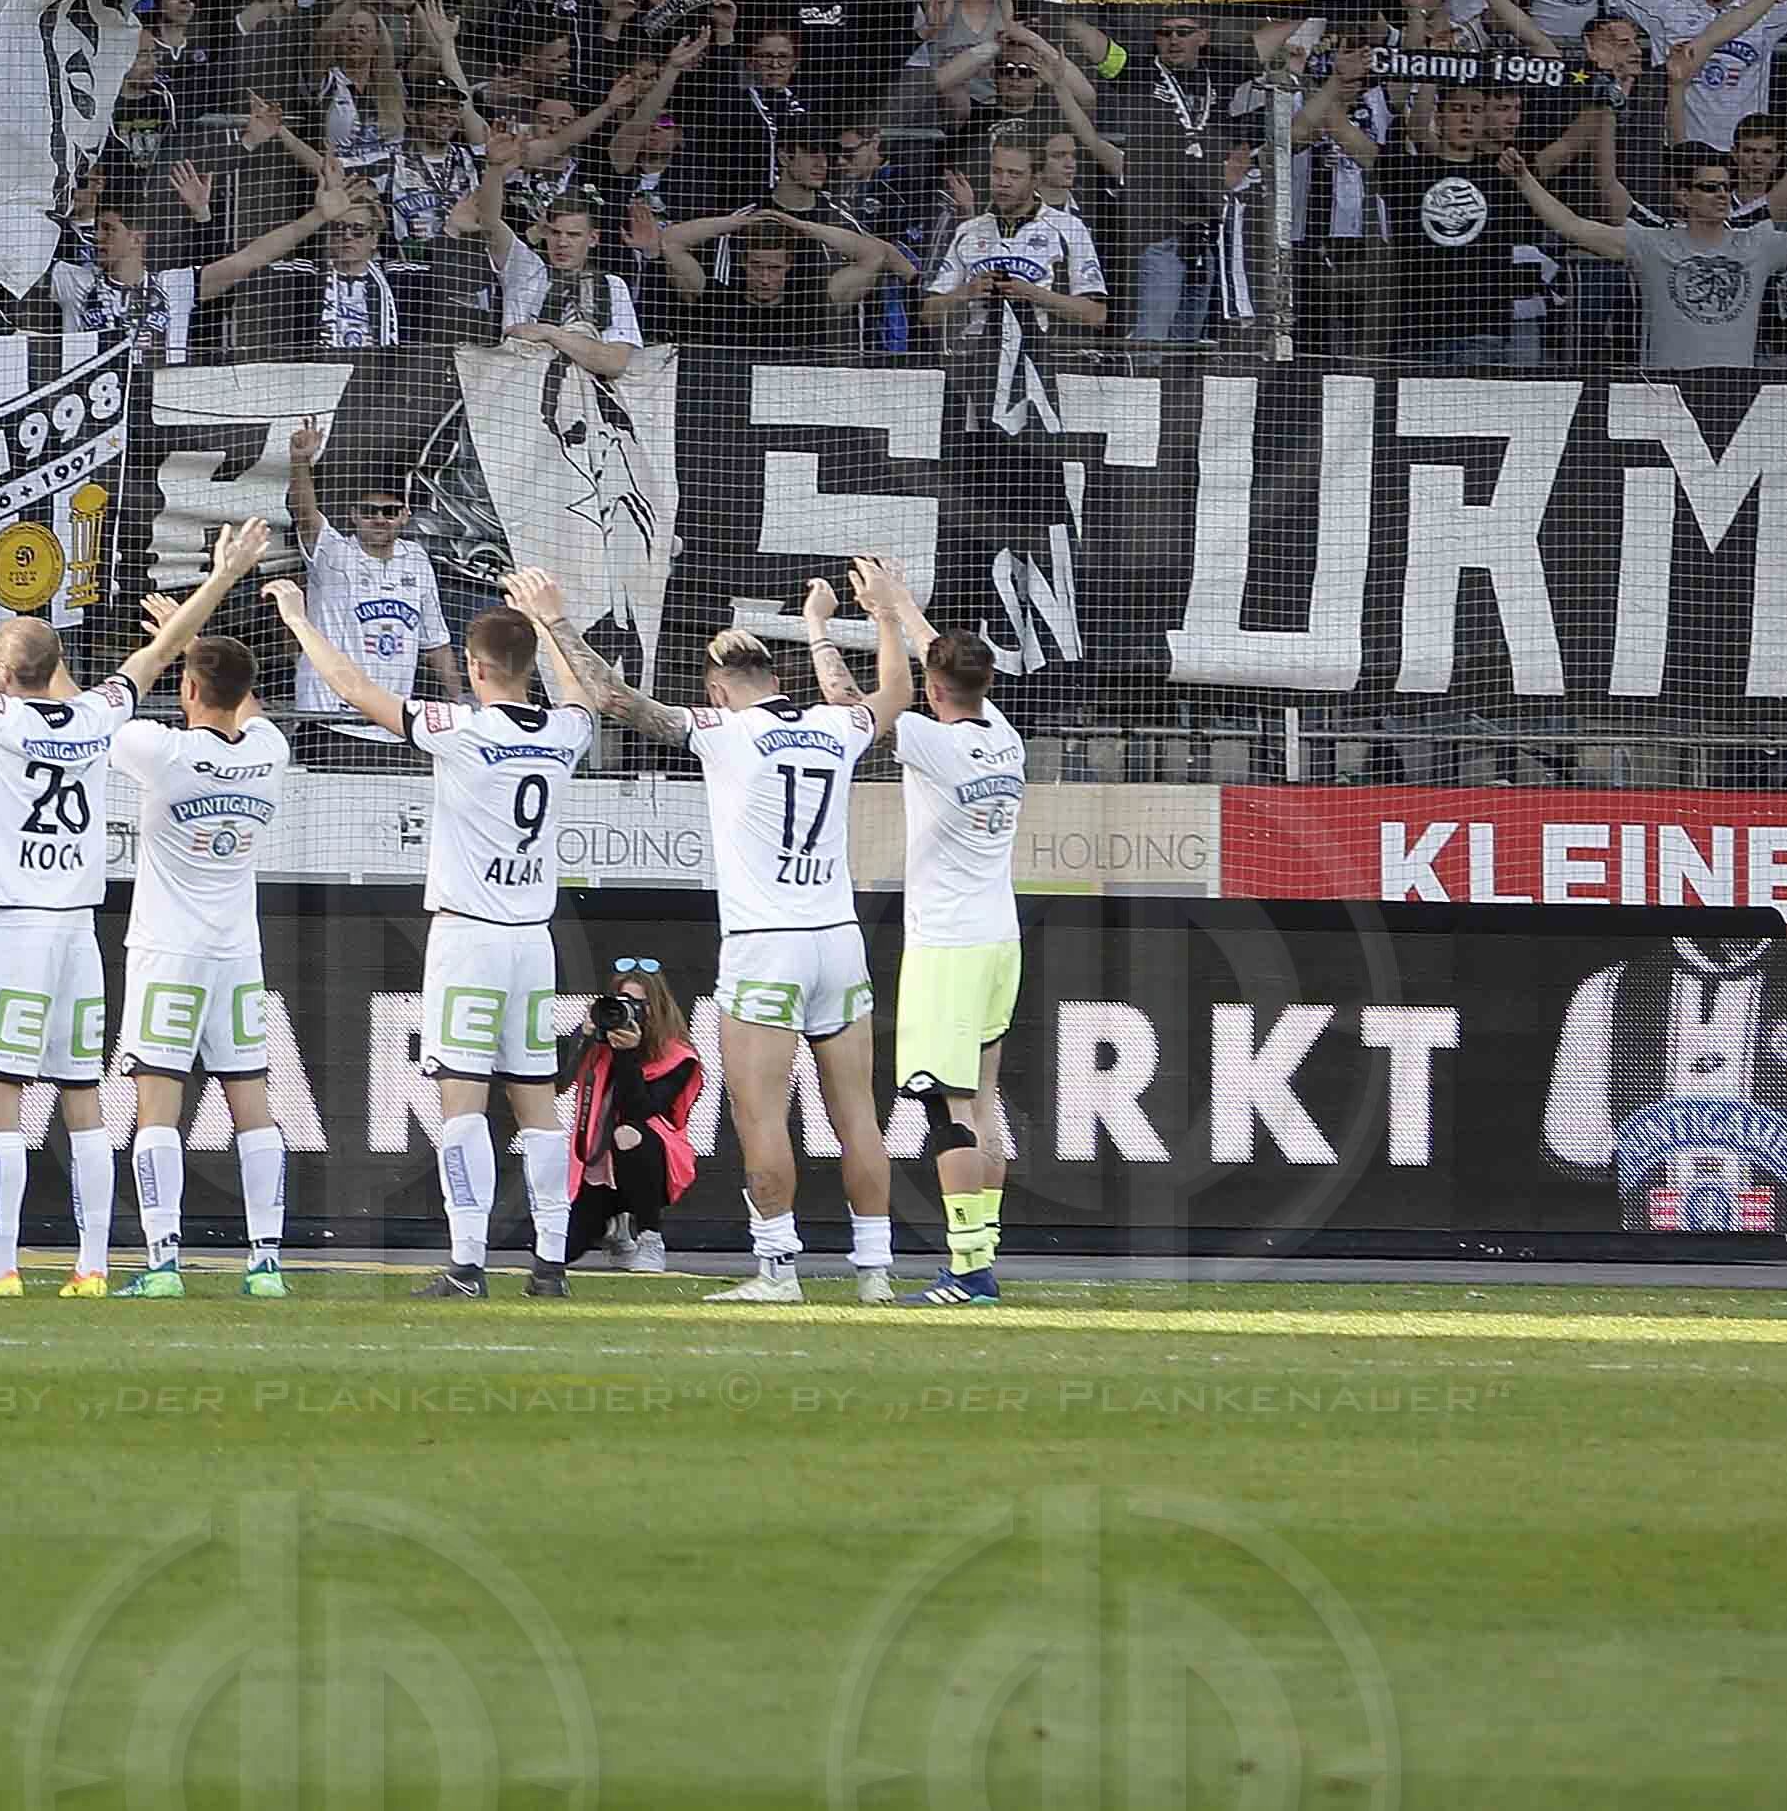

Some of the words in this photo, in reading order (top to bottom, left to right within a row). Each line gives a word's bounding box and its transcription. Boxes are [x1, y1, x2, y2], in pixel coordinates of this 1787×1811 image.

[1367, 46, 1479, 82] Champ
[1491, 53, 1566, 87] 1998
[39, 450, 98, 487] 1997
[213, 763, 273, 780] LOTTO
[513, 773, 549, 854] 9
[777, 763, 837, 855] 17
[556, 821, 706, 869] OLDING
[1030, 830, 1208, 873] HOLDING
[484, 856, 544, 887] ALAR
